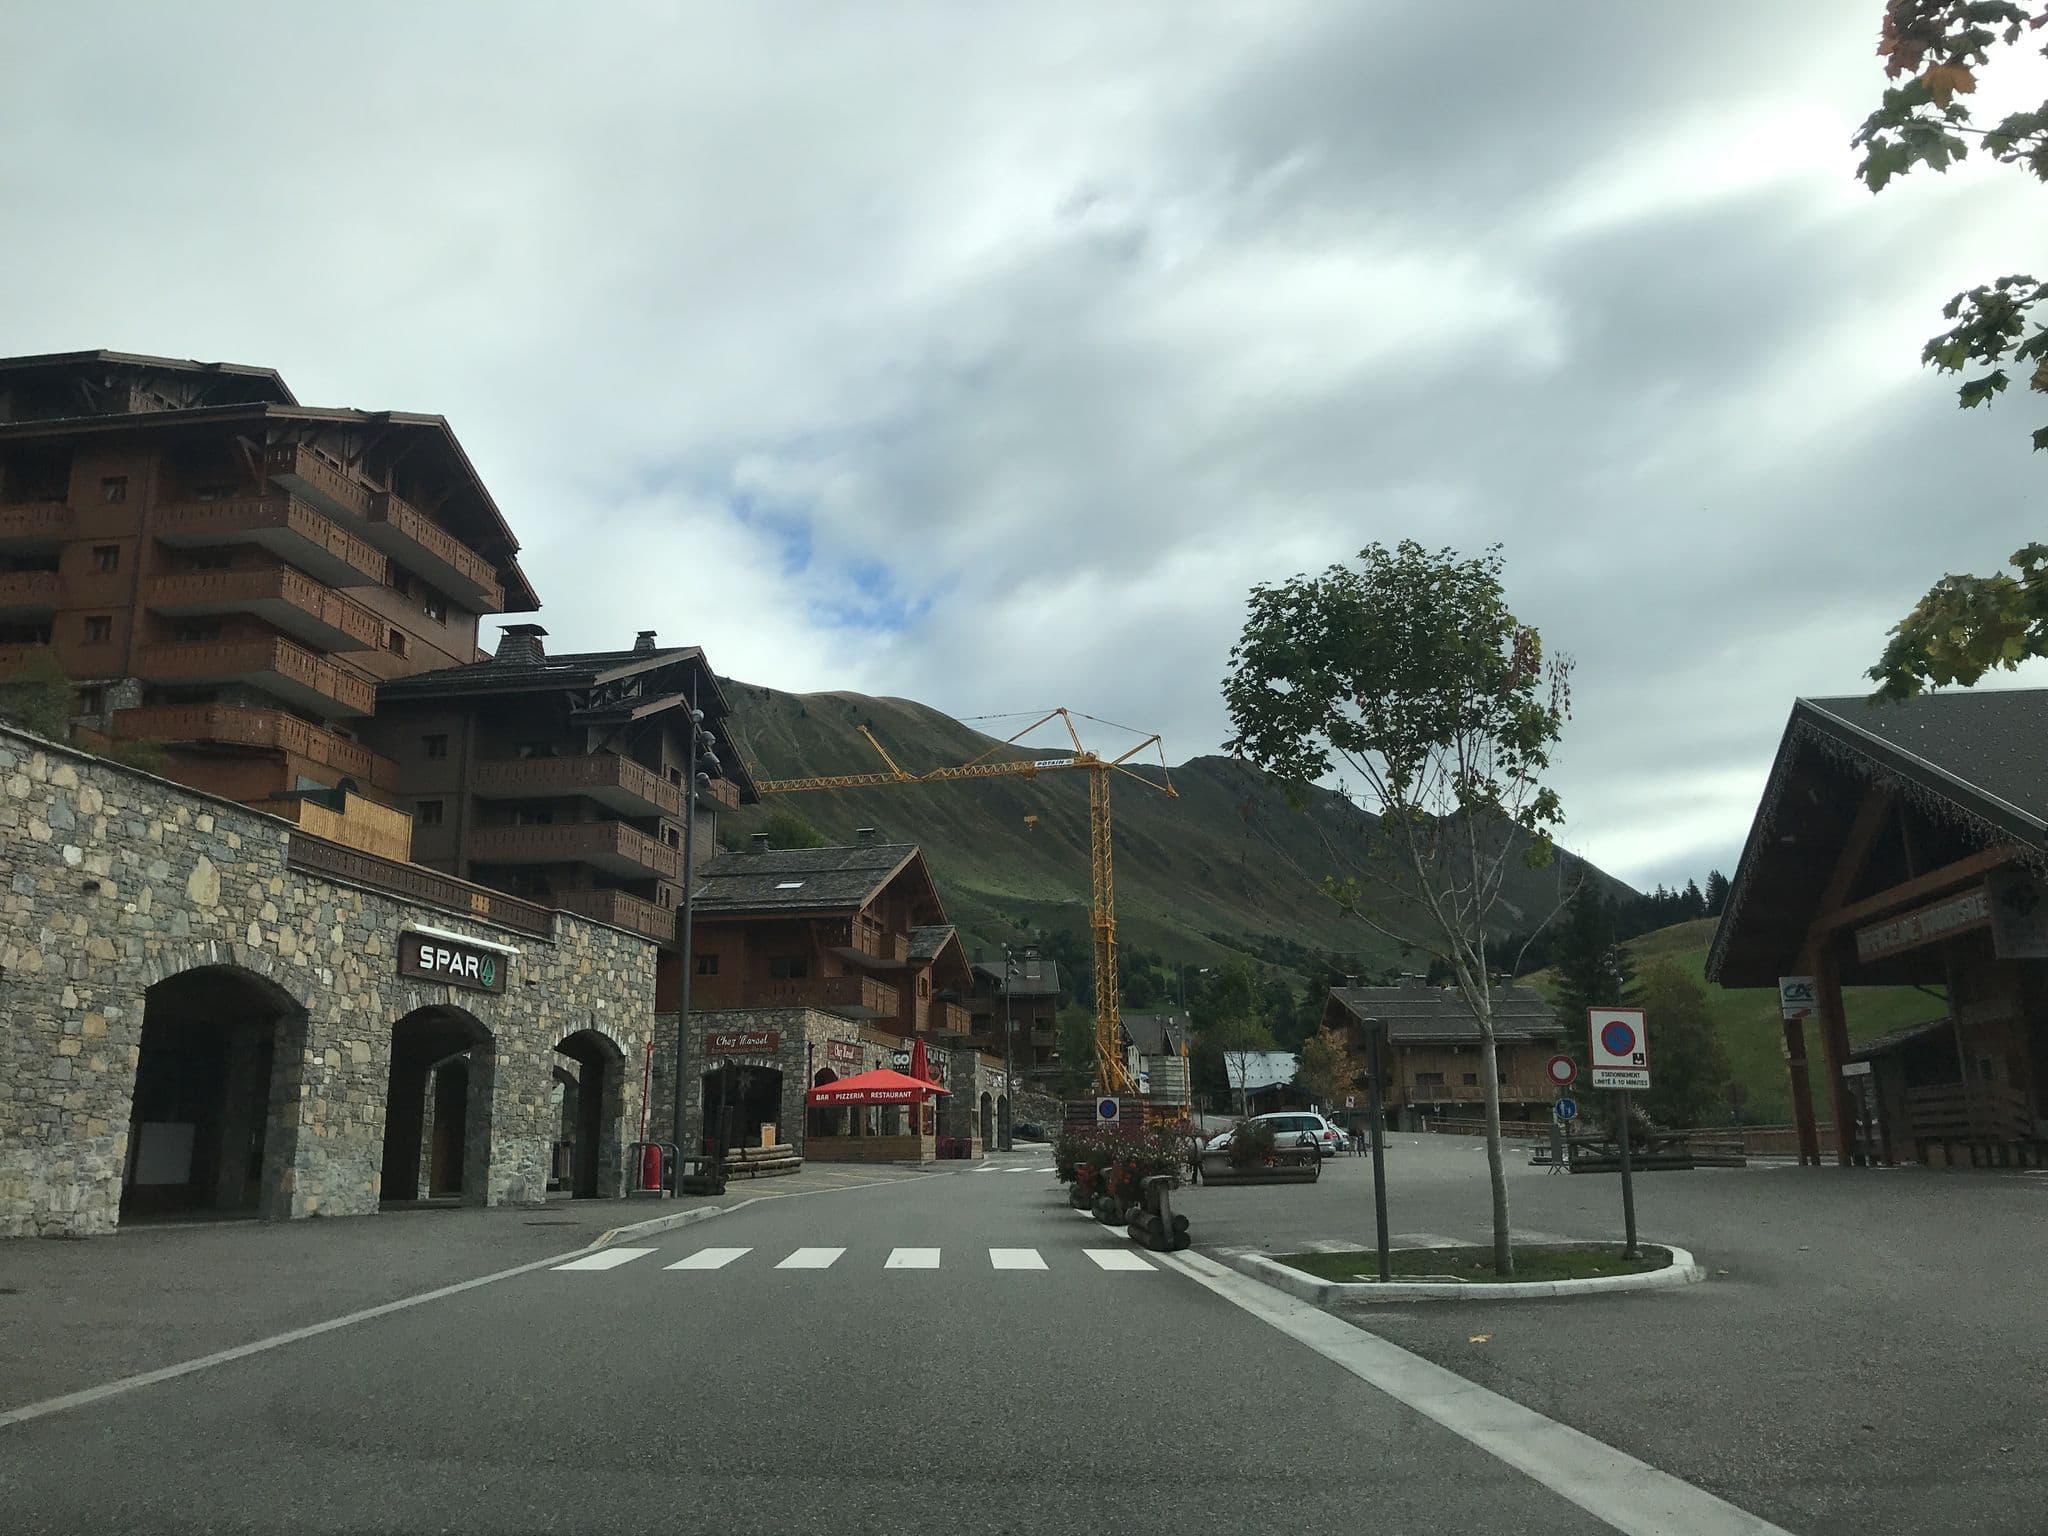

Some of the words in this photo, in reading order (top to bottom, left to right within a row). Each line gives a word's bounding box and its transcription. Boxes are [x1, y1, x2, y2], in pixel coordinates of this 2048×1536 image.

[419, 945, 479, 979] SPAR
[893, 1054, 910, 1066] GO
[835, 1092, 865, 1100] PIZZERIA
[870, 1091, 912, 1099] RESTAURANT
